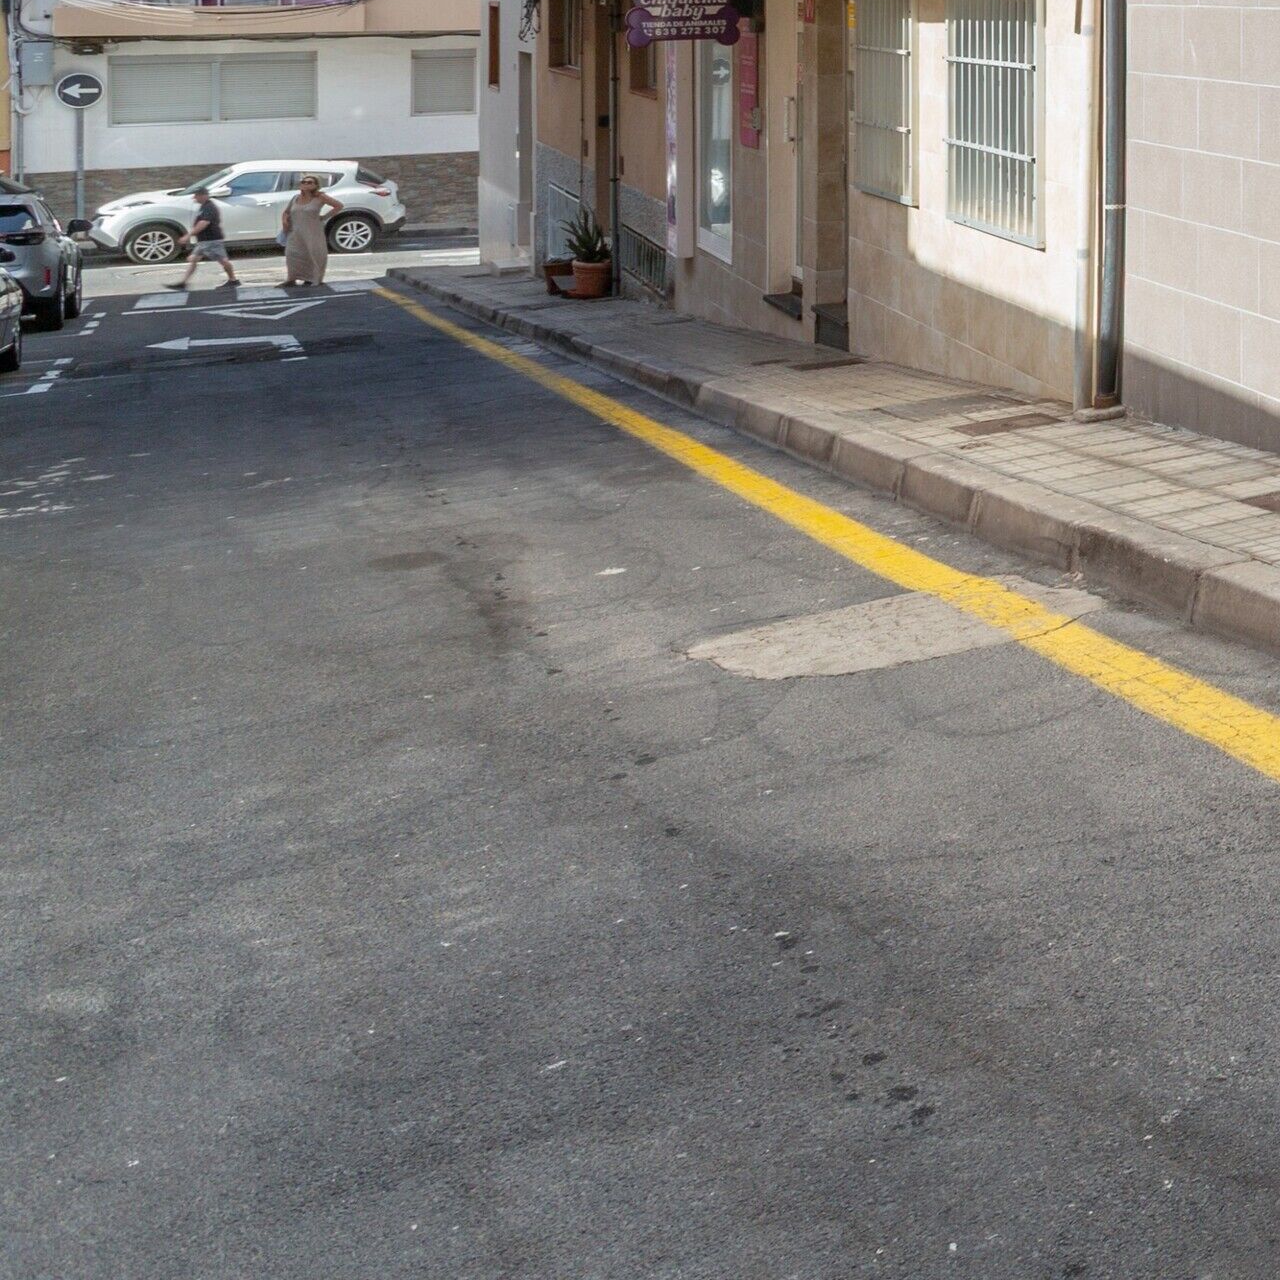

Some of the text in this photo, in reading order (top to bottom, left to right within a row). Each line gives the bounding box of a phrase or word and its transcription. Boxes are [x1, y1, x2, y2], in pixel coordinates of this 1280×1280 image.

[661, 4, 705, 20] baby
[685, 19, 727, 27] ANIMALES
[655, 26, 726, 36] 639 272 307
